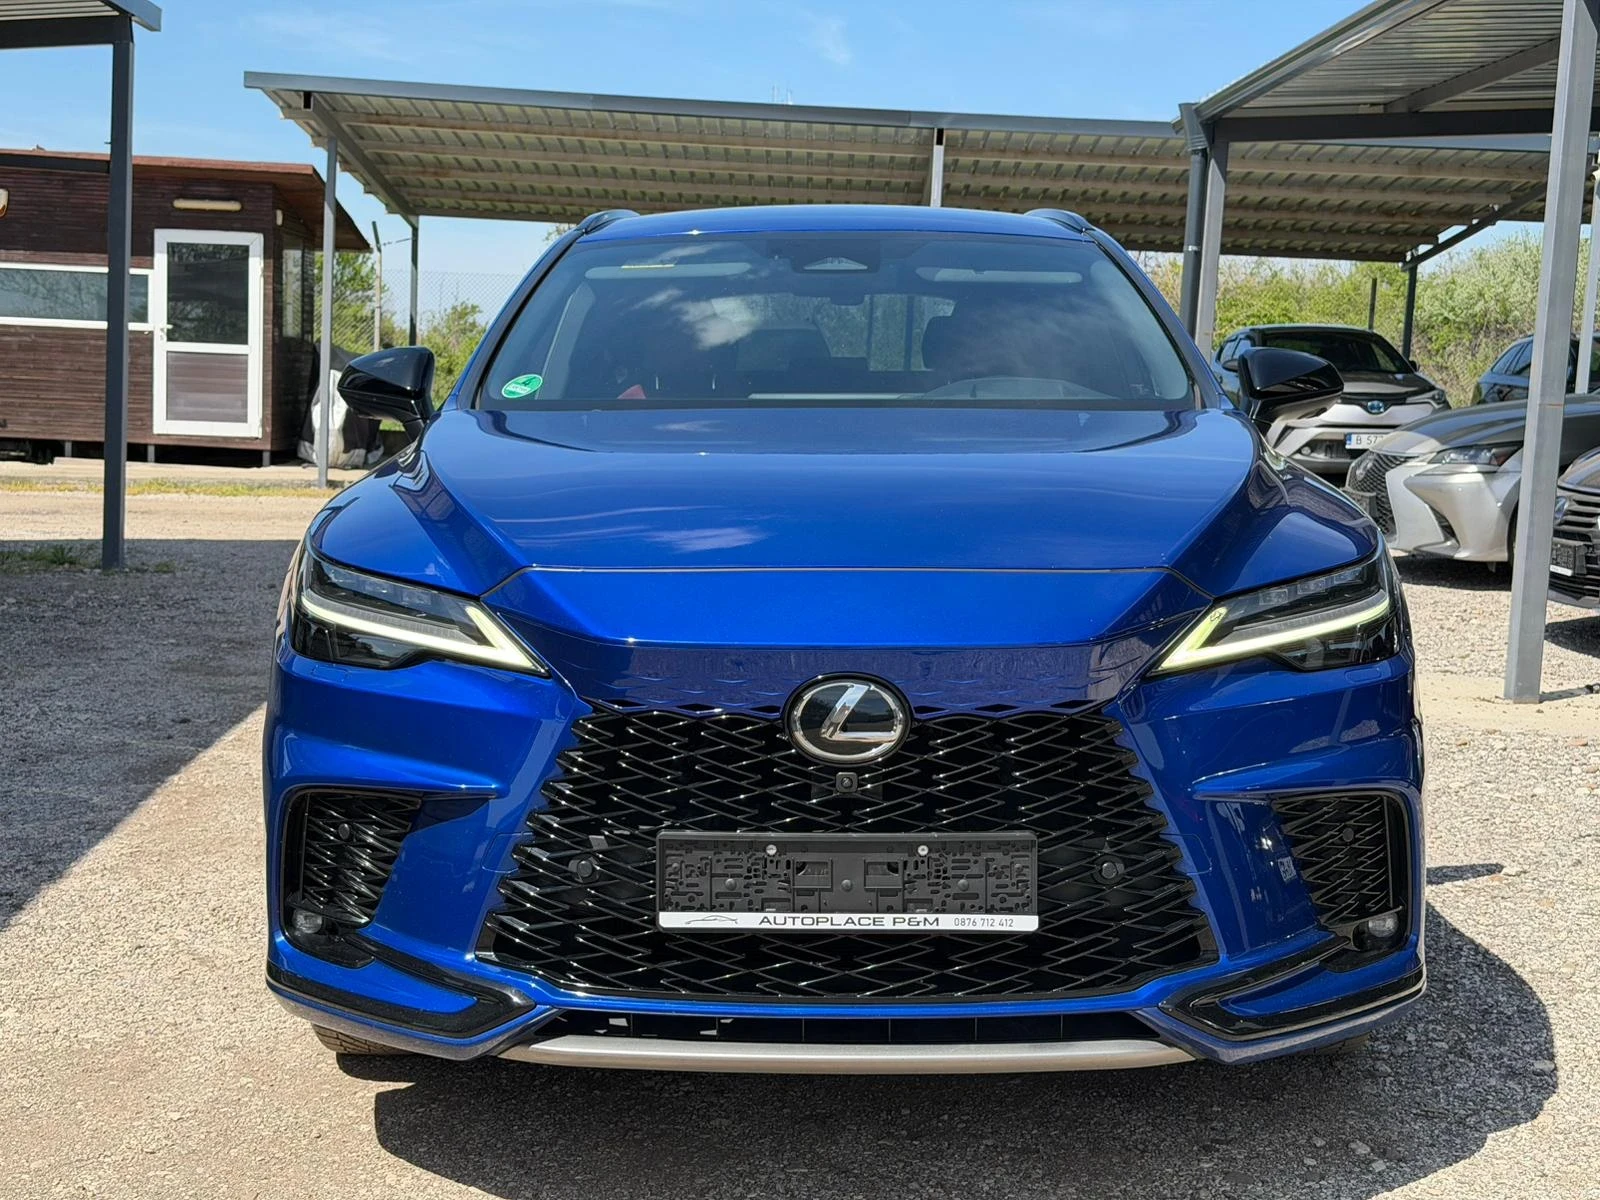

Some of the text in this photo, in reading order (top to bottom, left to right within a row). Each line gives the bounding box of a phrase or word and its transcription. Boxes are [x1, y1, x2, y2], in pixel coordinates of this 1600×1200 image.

[758, 915, 1014, 928] AUTOPLACE P&M 0876 712 412
